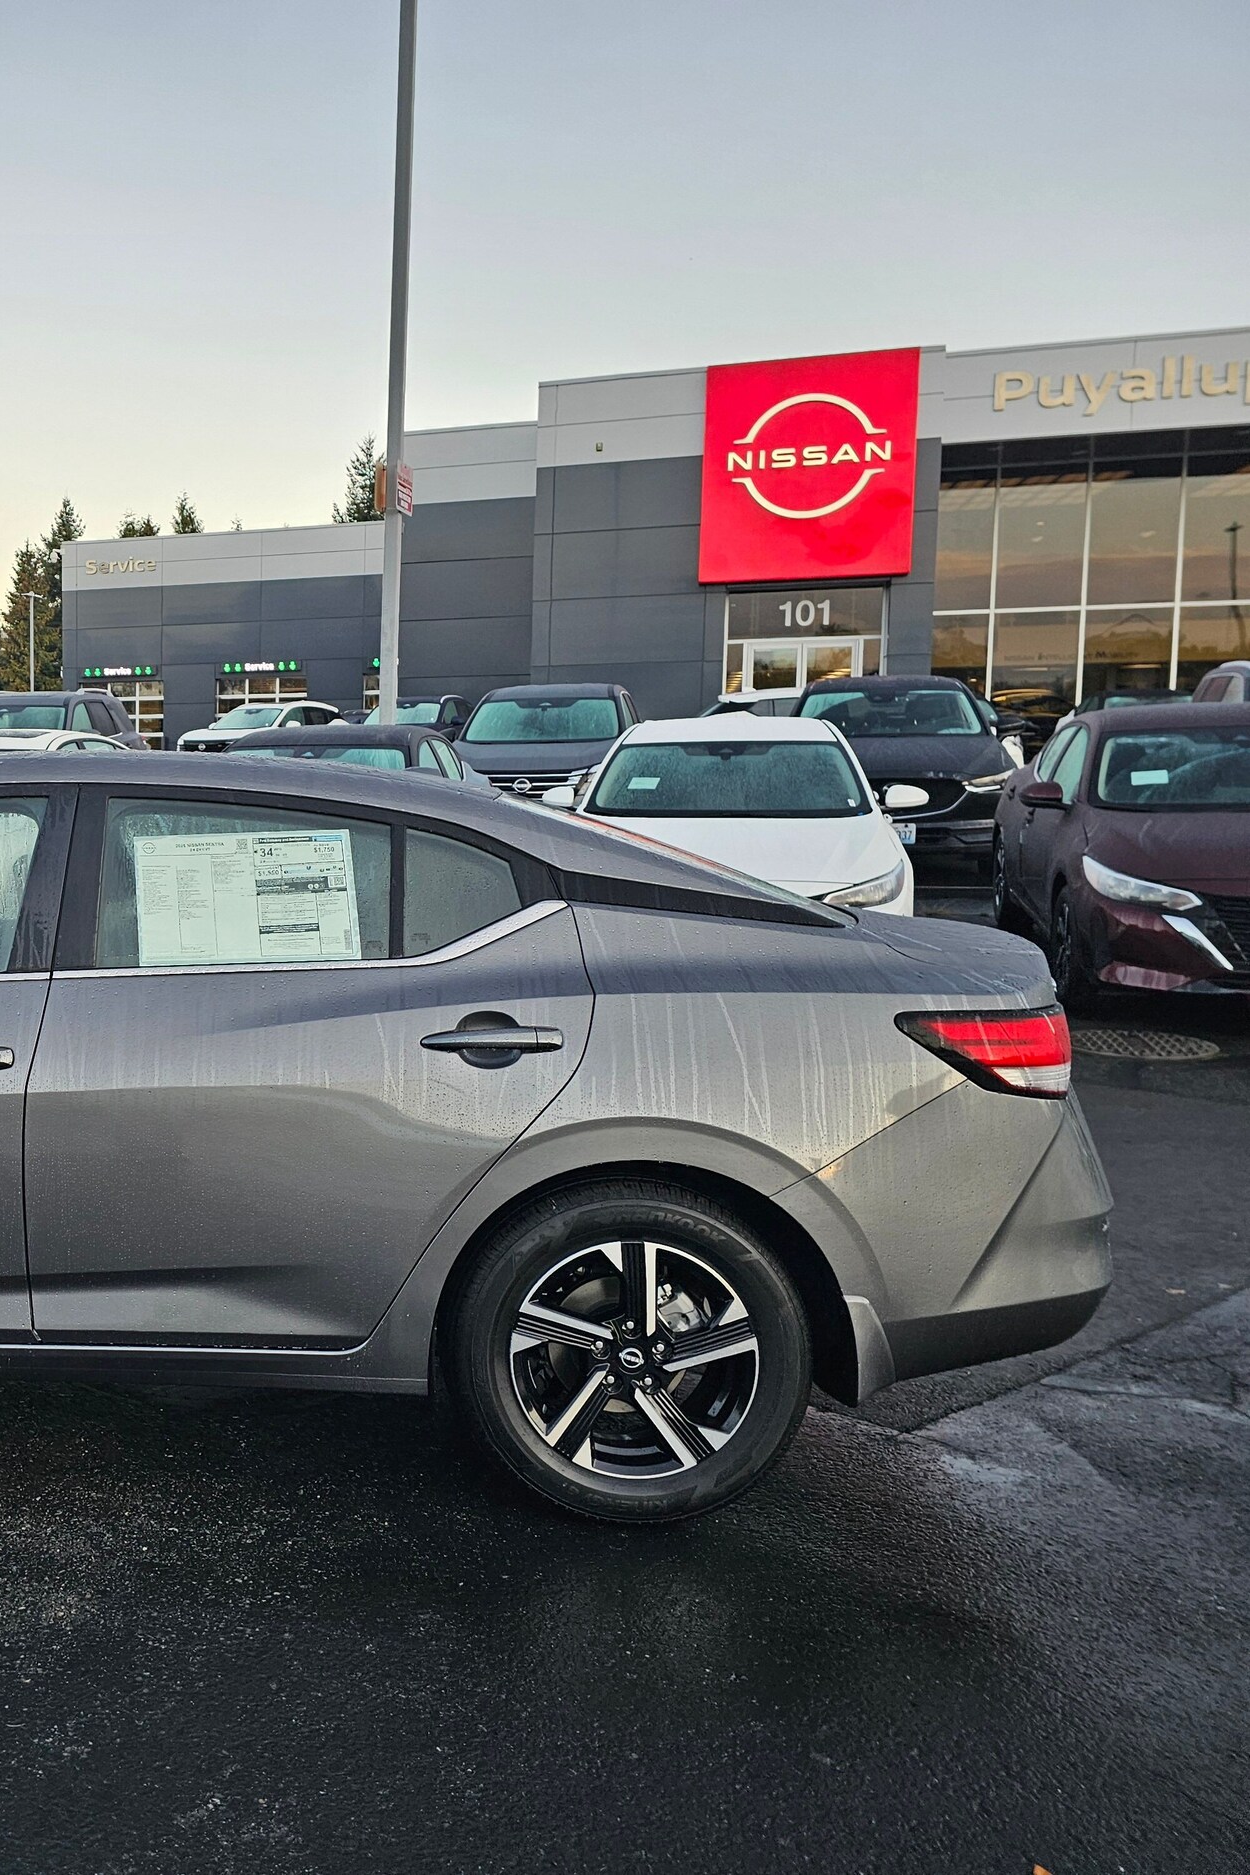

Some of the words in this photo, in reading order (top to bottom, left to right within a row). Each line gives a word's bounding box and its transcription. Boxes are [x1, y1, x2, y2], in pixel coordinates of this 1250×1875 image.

[727, 440, 892, 472] NISSAN
[85, 556, 157, 575] Service
[779, 599, 830, 627] 101
[103, 666, 132, 676] Service
[244, 661, 275, 671] Service
[260, 847, 273, 857] 34
